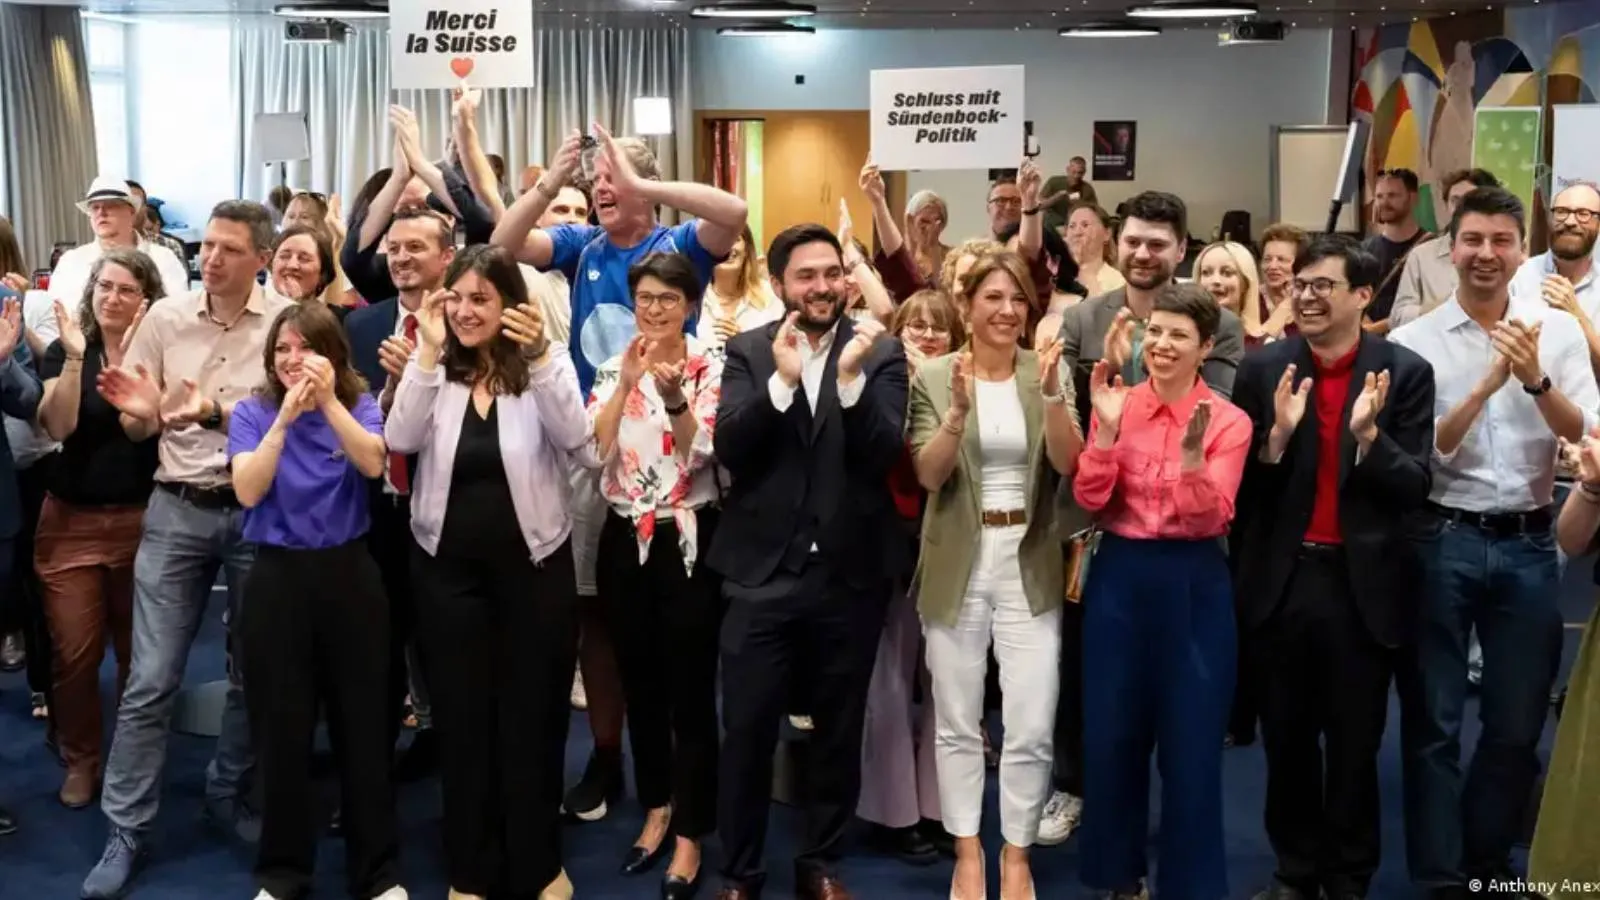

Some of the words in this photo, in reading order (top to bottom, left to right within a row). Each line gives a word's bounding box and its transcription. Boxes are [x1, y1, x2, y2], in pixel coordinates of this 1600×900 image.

[426, 9, 497, 30] Merci
[406, 33, 429, 53] la
[435, 32, 516, 53] Suisse
[894, 93, 964, 107] Schluss
[968, 90, 1000, 105] mit
[888, 109, 1008, 125] Sündenbock-
[916, 127, 977, 143] Politik
